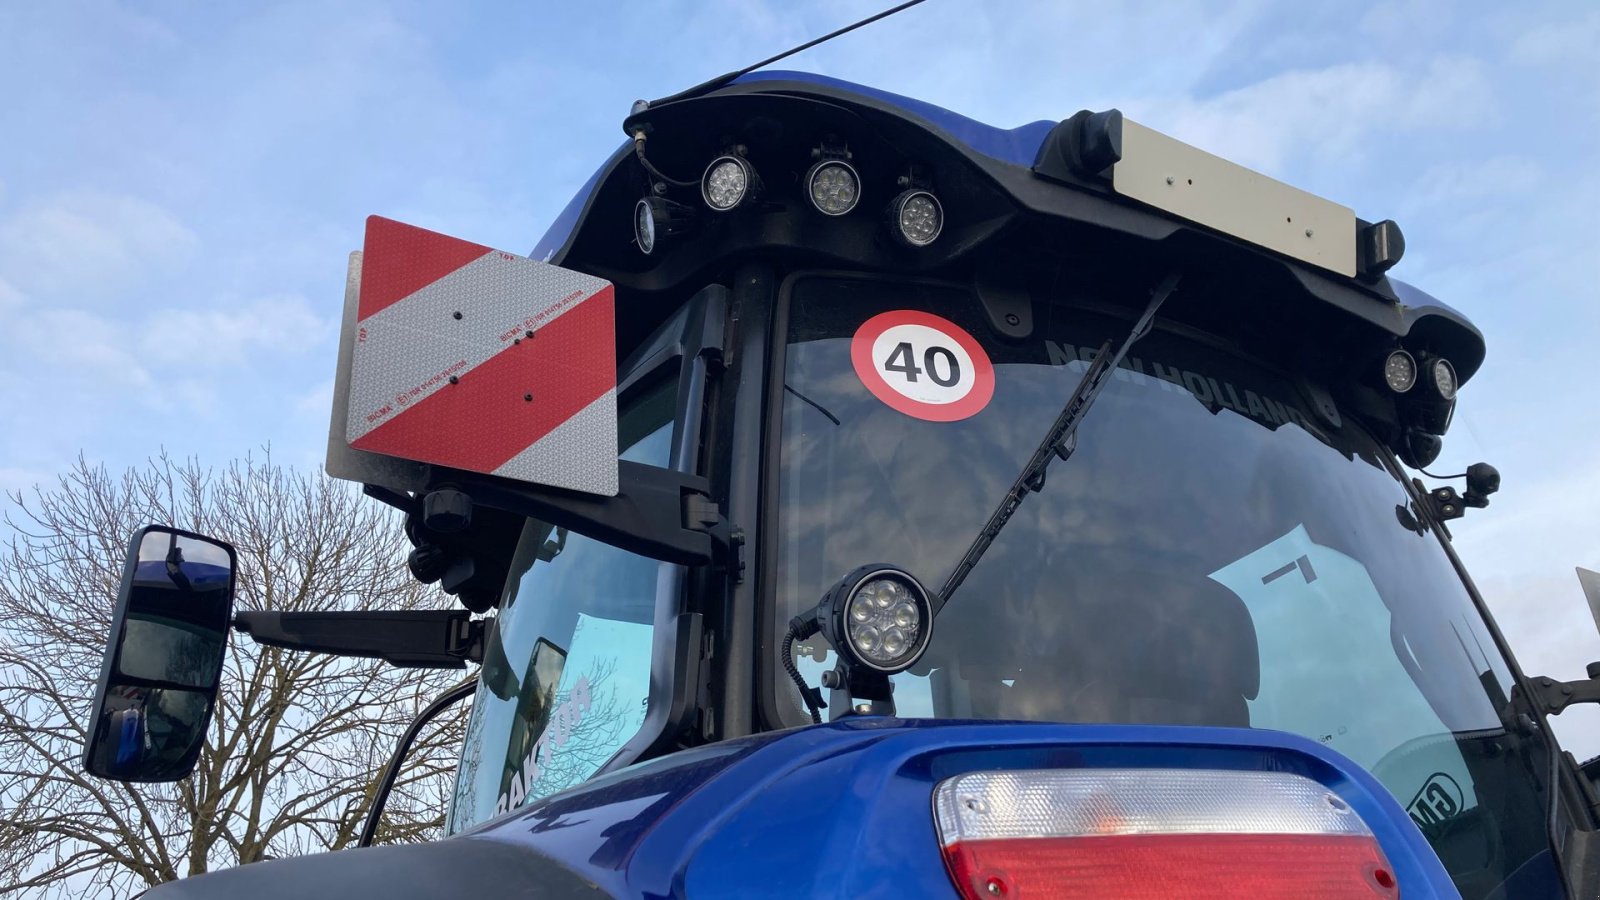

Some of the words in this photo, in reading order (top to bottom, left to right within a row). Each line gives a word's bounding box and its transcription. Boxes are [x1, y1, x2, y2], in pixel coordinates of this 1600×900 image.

[500, 252, 514, 261] TOP
[359, 327, 367, 342] TOP
[501, 324, 523, 341] BICMA
[885, 341, 961, 388] 40
[1152, 361, 1310, 428] HOLLAND
[366, 405, 393, 423] BICMA
[489, 676, 591, 819] RAKTOR
